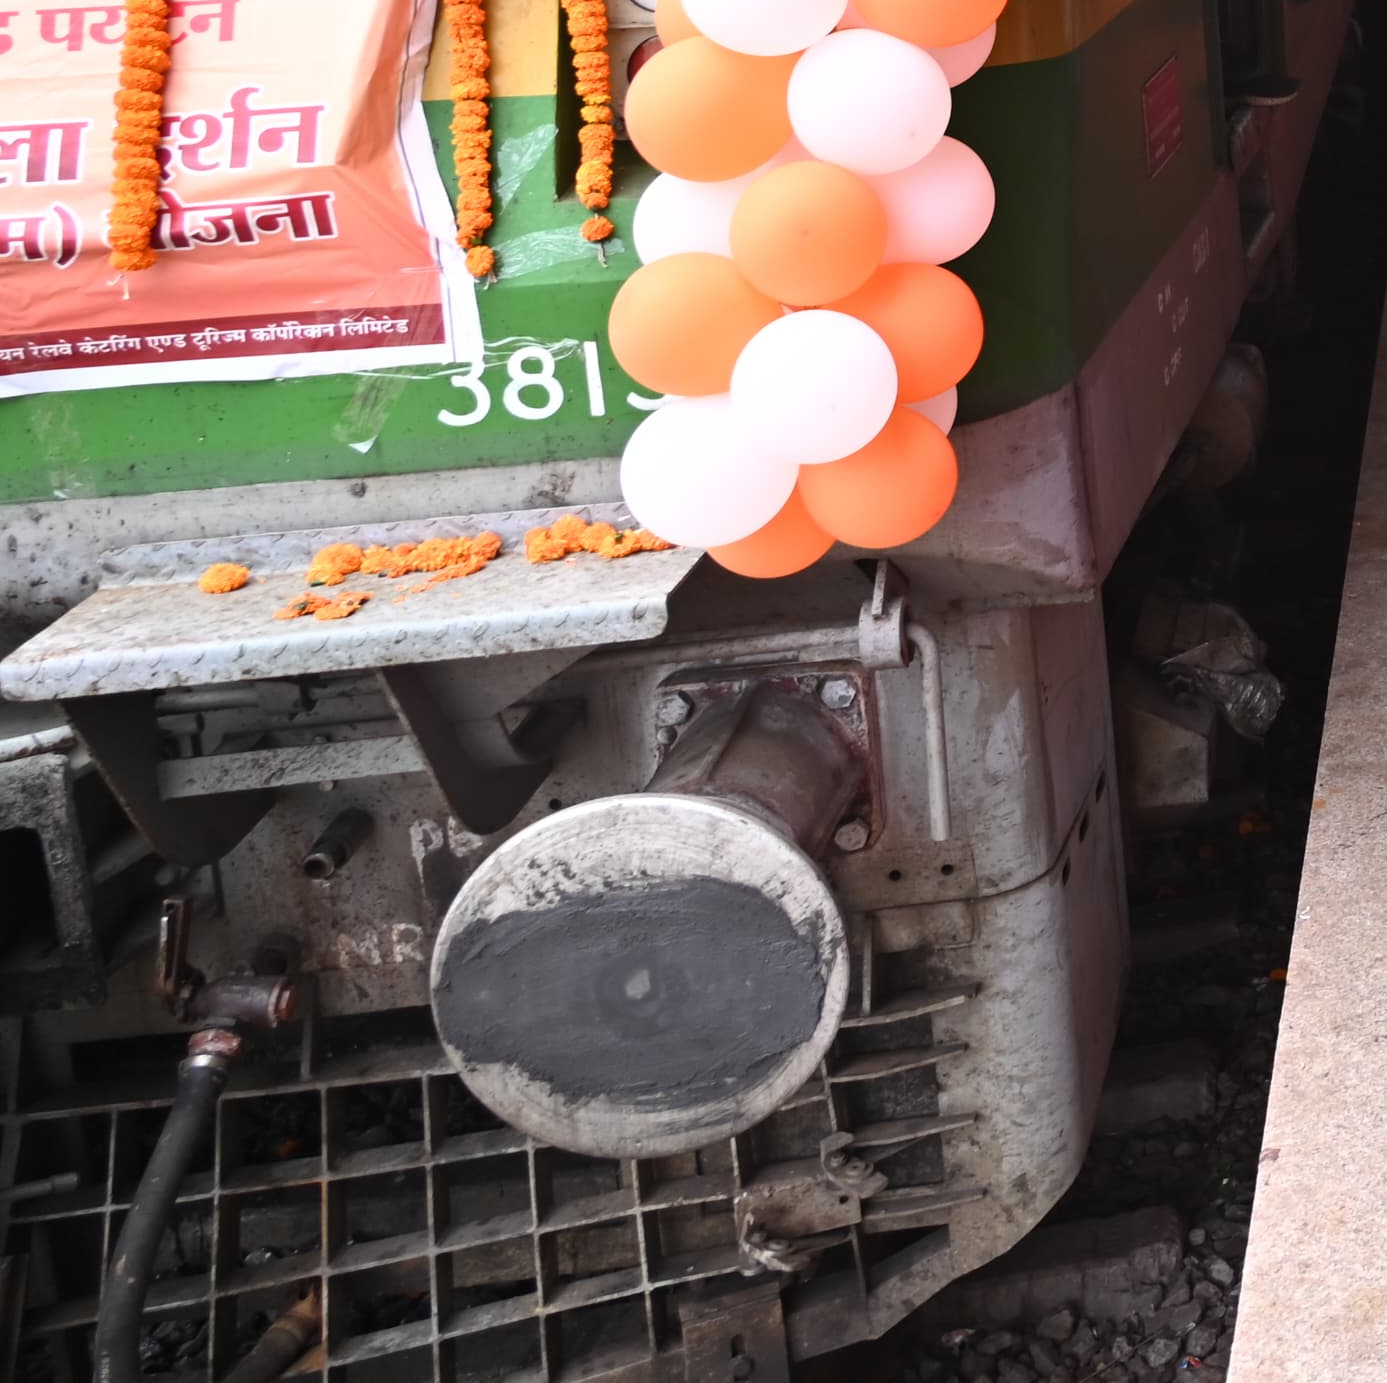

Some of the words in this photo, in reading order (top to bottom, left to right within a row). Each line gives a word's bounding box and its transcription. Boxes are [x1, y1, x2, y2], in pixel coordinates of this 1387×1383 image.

[29, 339, 72, 358] रेलवे
[339, 315, 409, 337] लिमिटेड
[437, 340, 676, 427] 381
